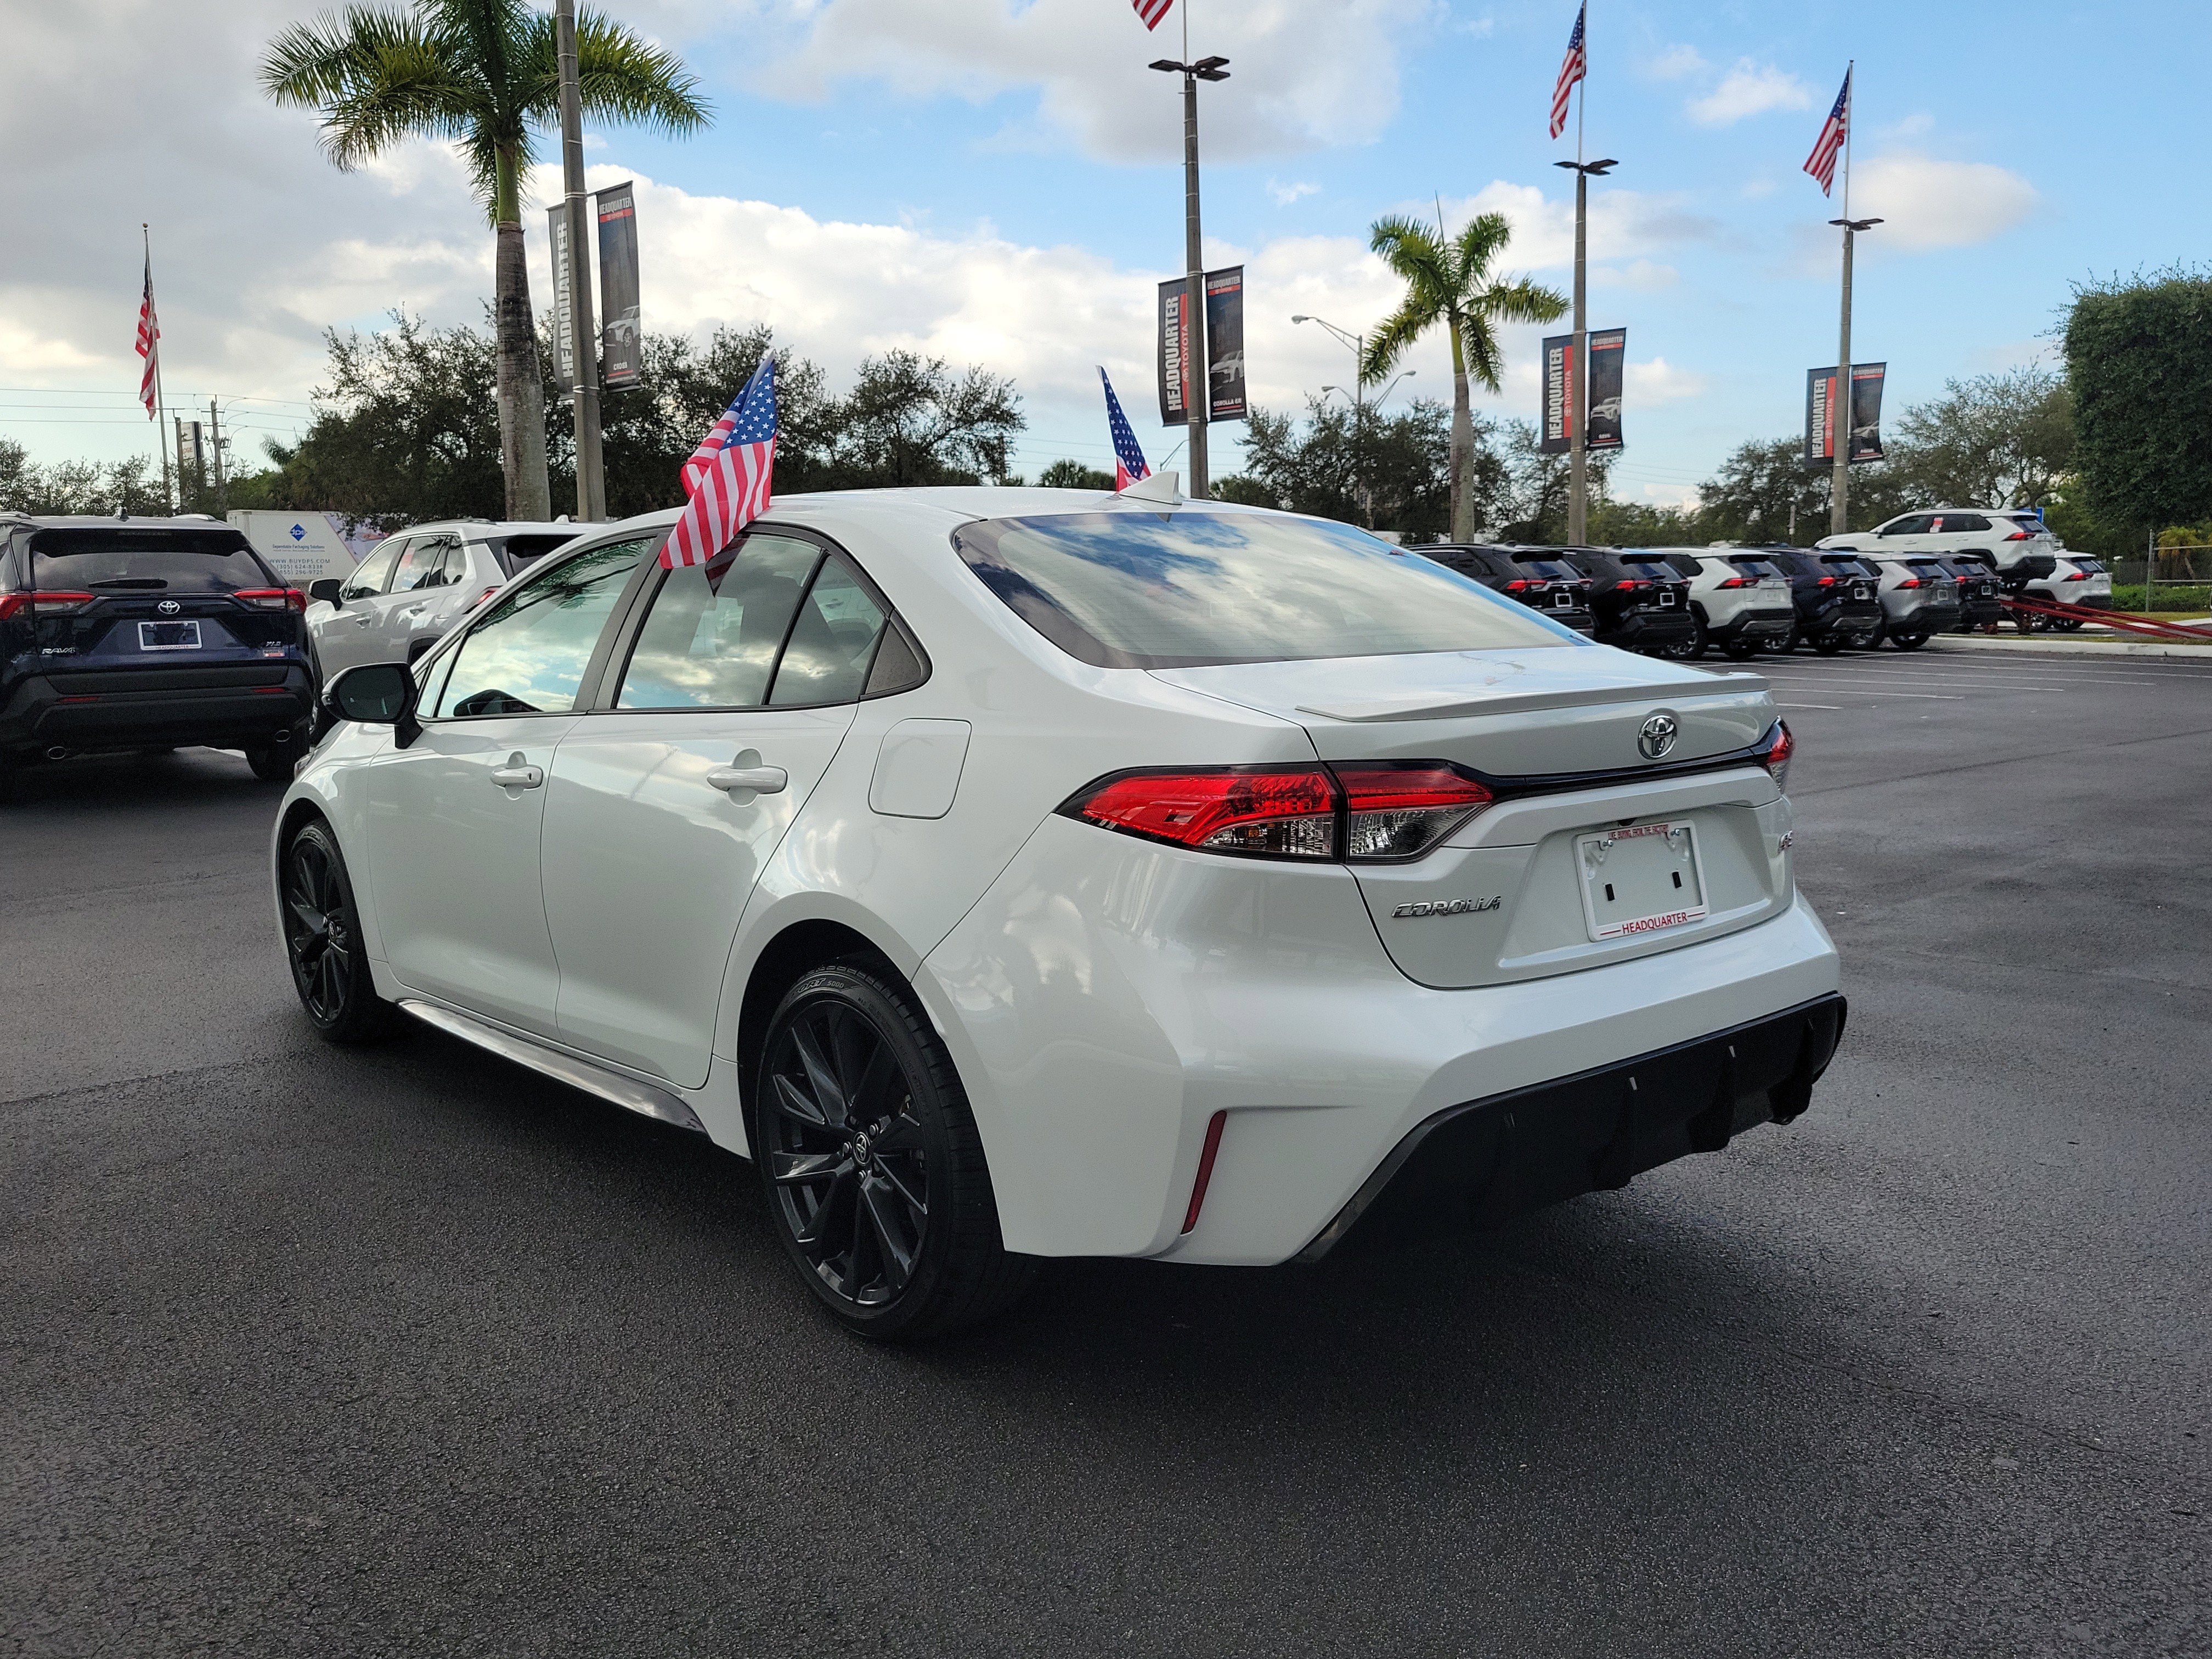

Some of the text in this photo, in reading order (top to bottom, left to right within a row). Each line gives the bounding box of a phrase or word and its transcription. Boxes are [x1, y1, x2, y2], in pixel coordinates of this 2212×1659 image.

[1165, 296, 1181, 411] HEADQUARTER
[1549, 348, 1564, 439] HEADQUARTER
[1812, 378, 1827, 459] HEADQUARTER
[1391, 895, 1502, 917] COROLLA
[1622, 912, 1688, 934] HEADQUARTER
[827, 980, 844, 989] 5000
